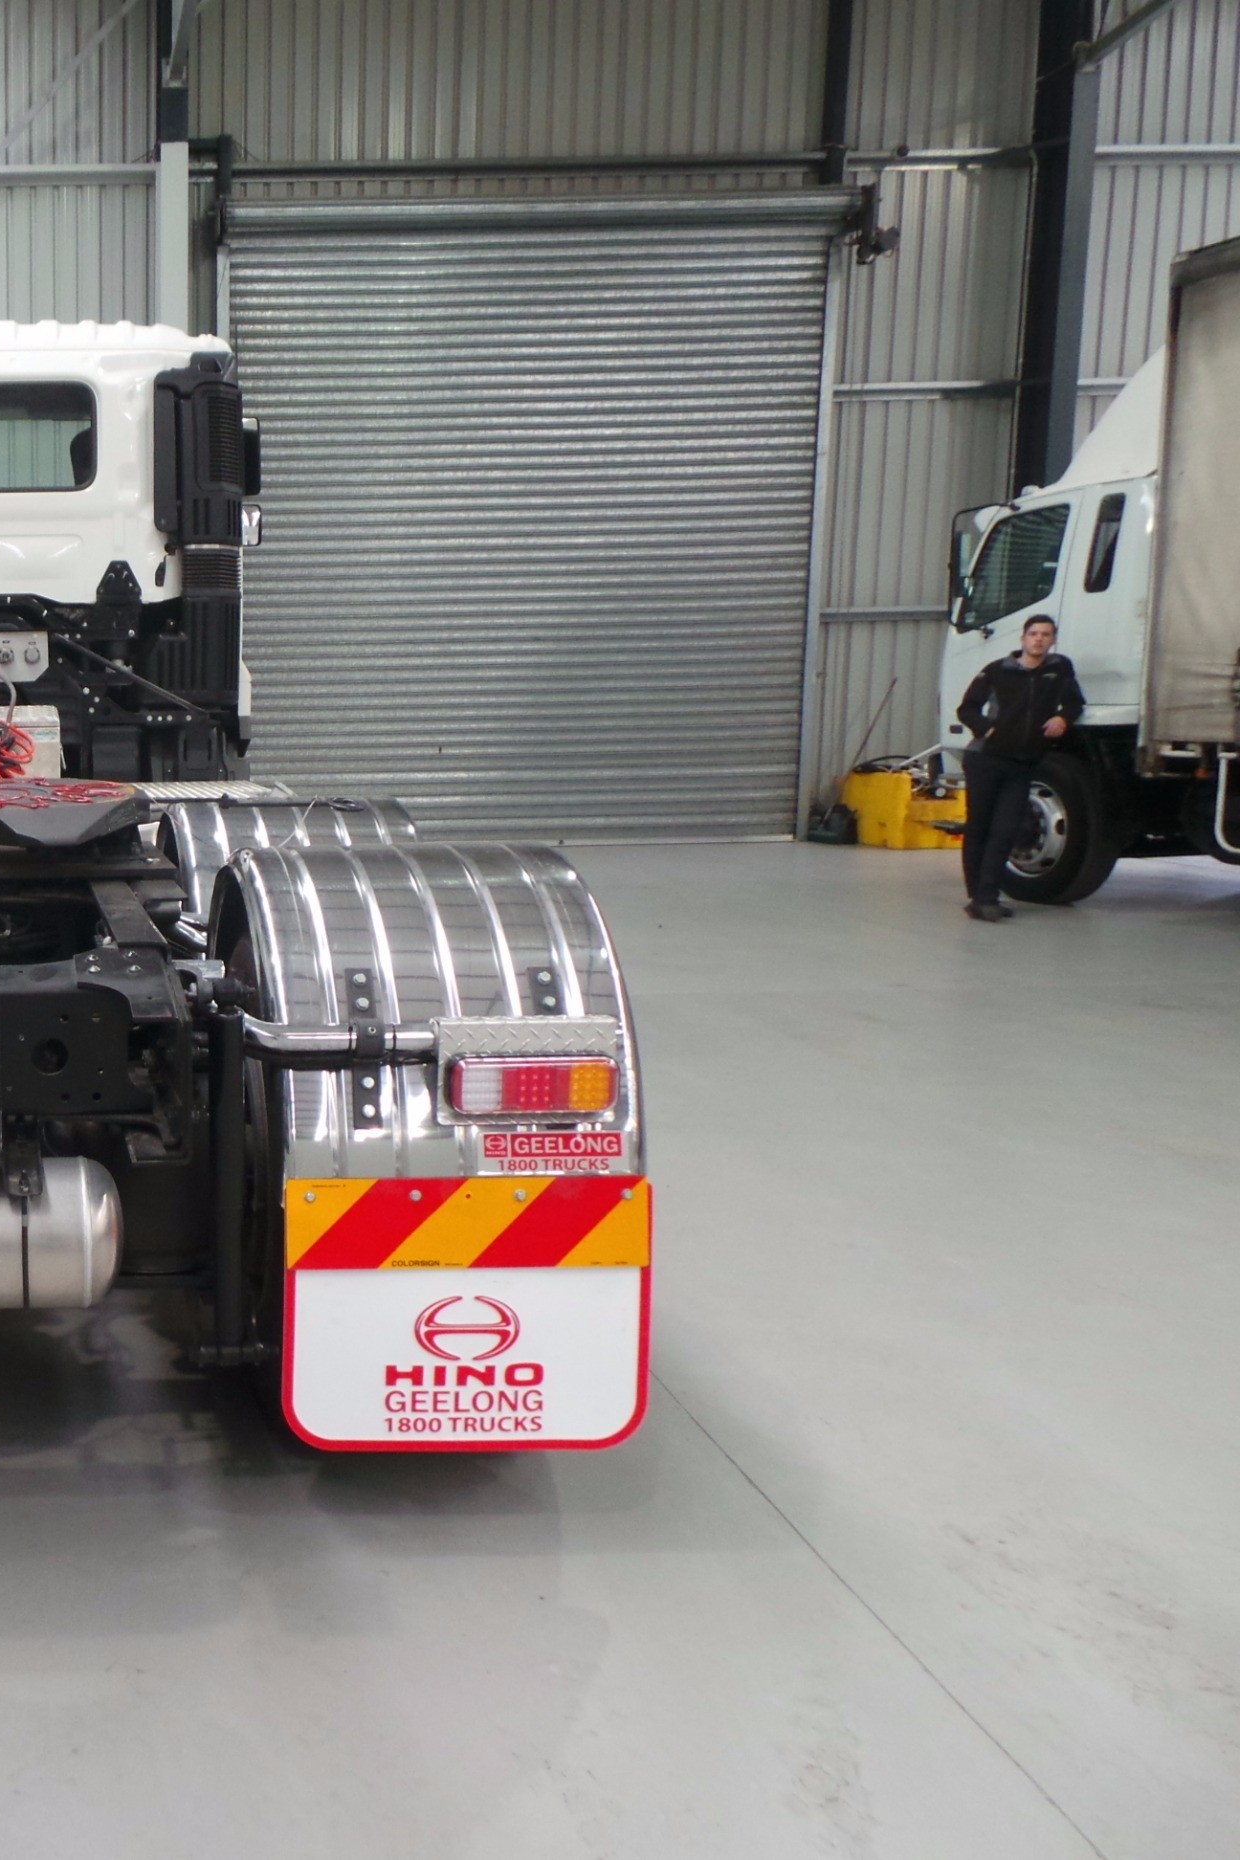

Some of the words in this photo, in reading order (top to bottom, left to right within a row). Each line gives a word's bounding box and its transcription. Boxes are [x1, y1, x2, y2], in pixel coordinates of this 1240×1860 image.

[514, 1136, 619, 1154] GEELONG
[498, 1159, 538, 1171] 1800
[542, 1158, 610, 1171] TRUCKS
[392, 1259, 440, 1268] COLORSIGN
[385, 1362, 544, 1387] HINO
[385, 1389, 544, 1413] GEELONG
[384, 1417, 442, 1433] 1800
[447, 1415, 543, 1433] TRUCKS
